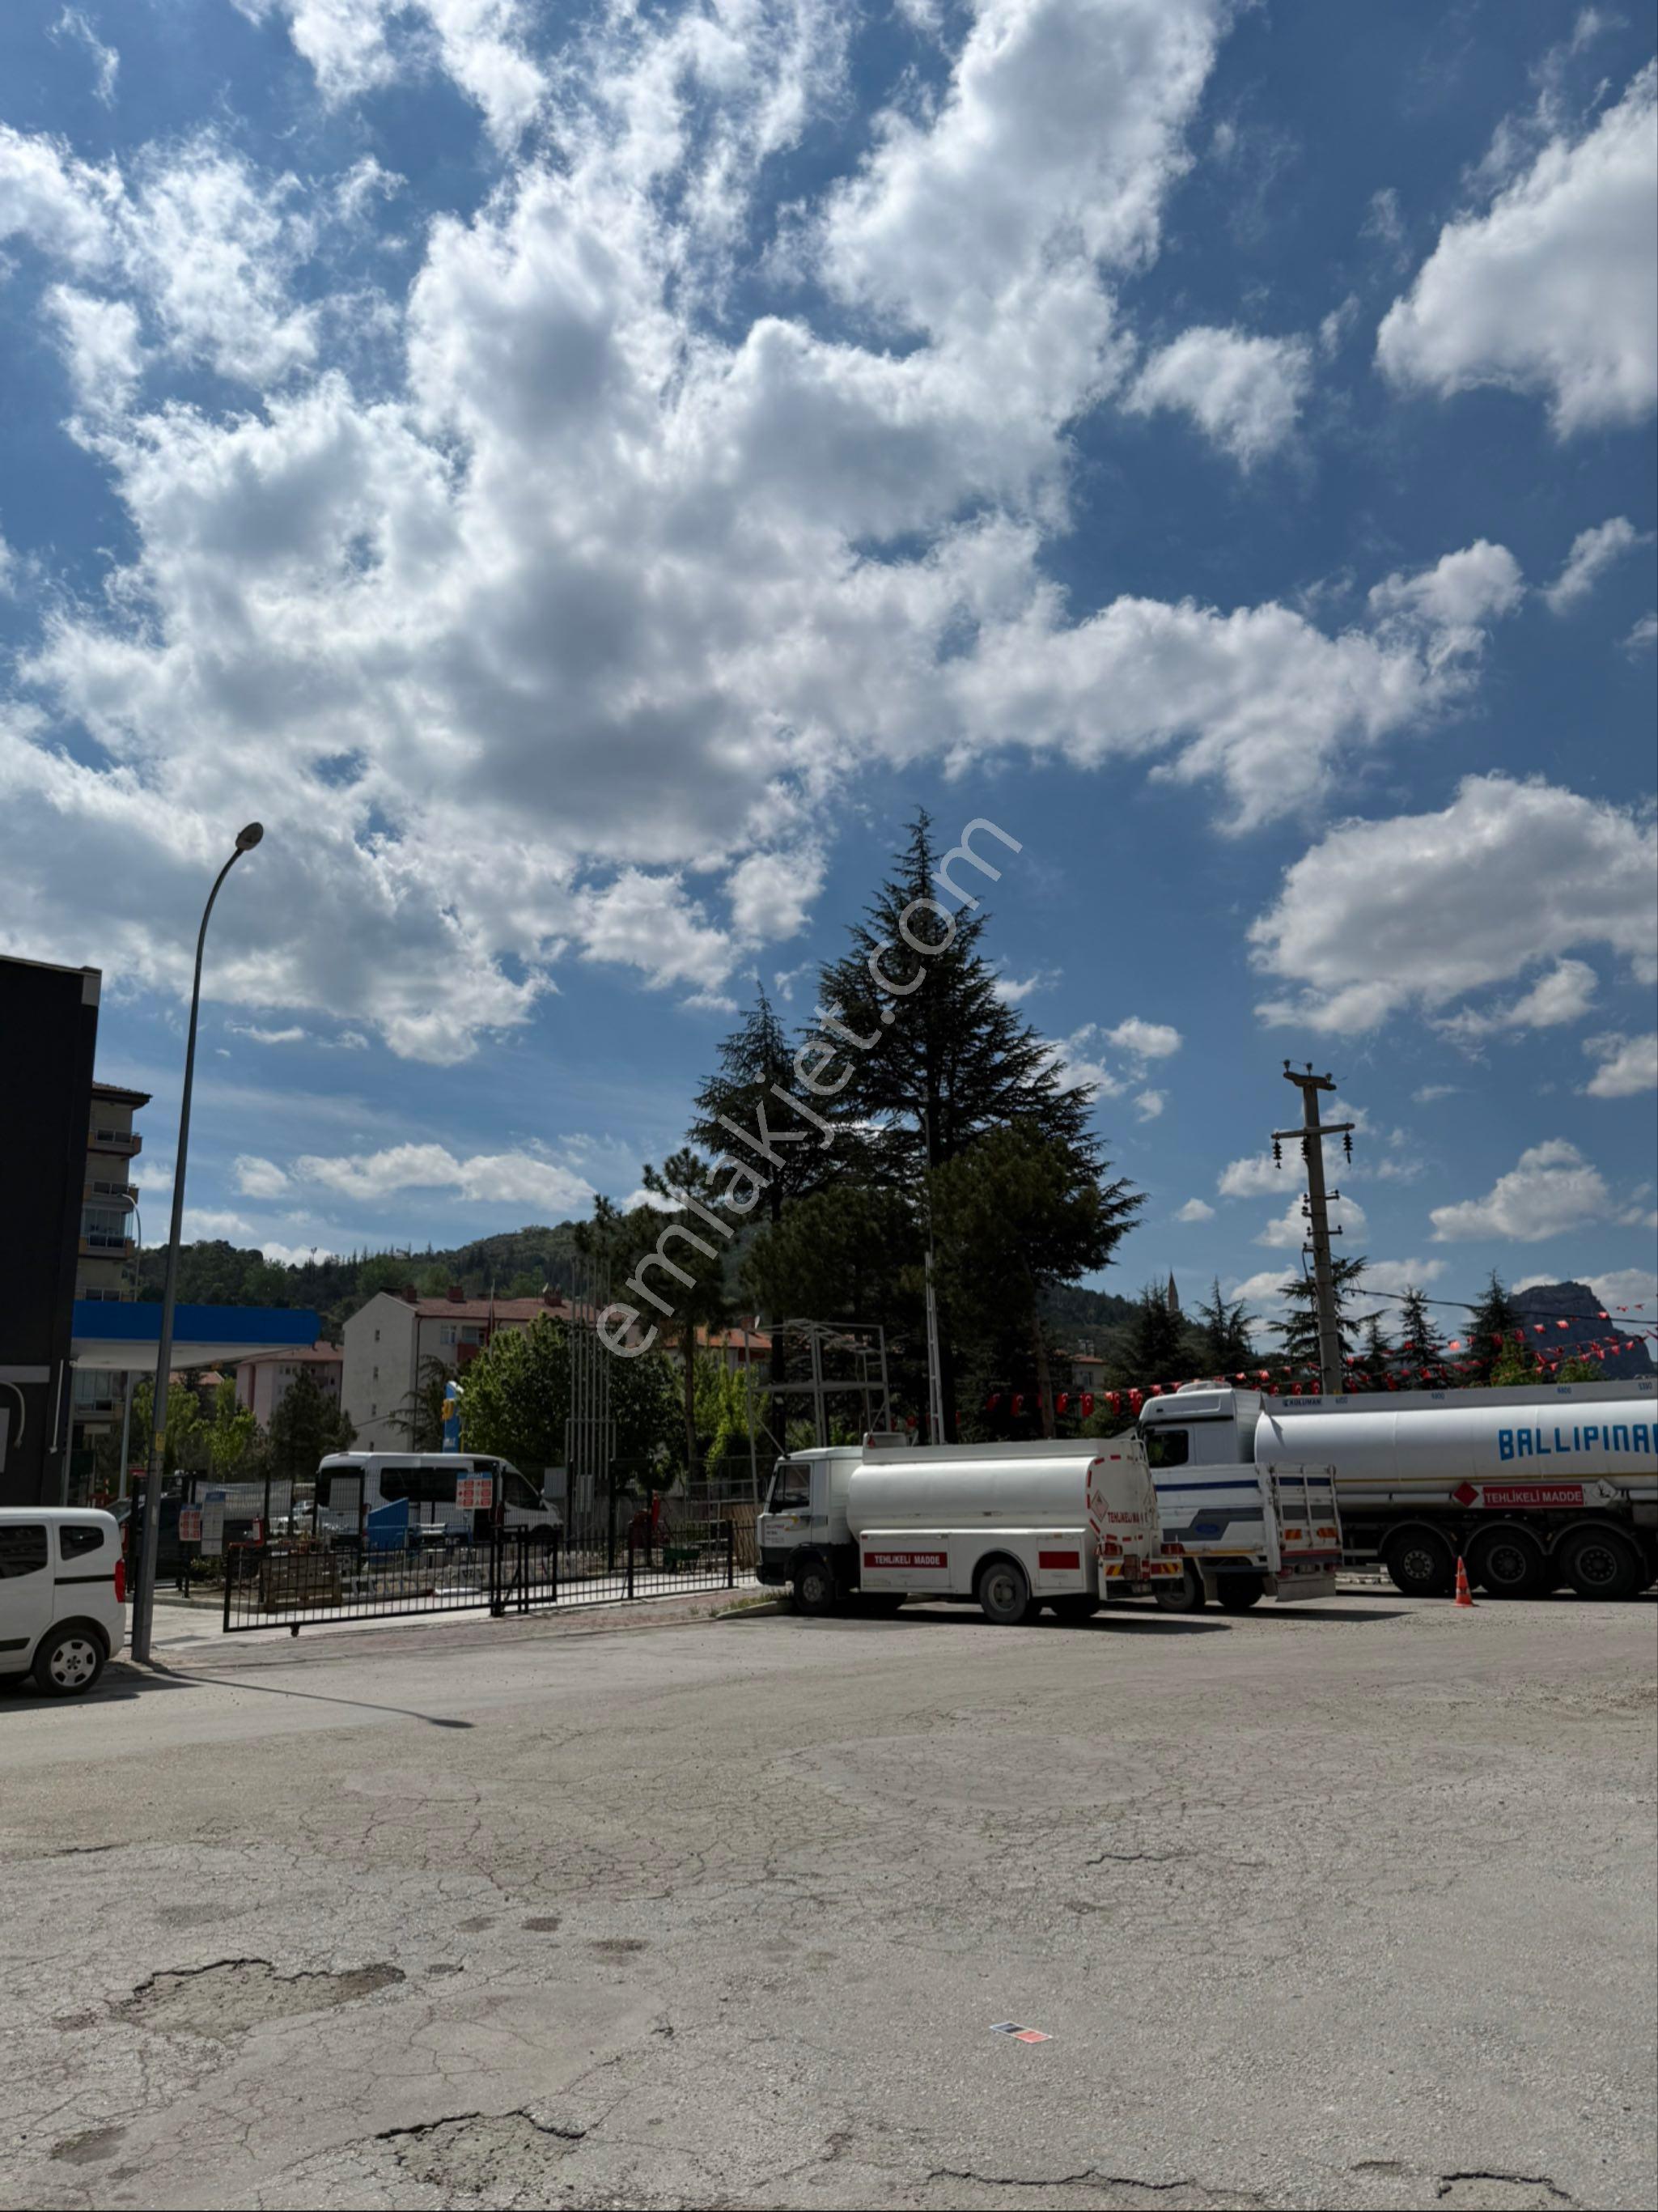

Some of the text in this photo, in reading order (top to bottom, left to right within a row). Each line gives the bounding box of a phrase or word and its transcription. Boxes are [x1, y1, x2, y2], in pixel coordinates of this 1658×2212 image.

[1485, 1488, 1583, 1504] TEHLİKELİ MADDE
[914, 1555, 940, 1565] MADDE
